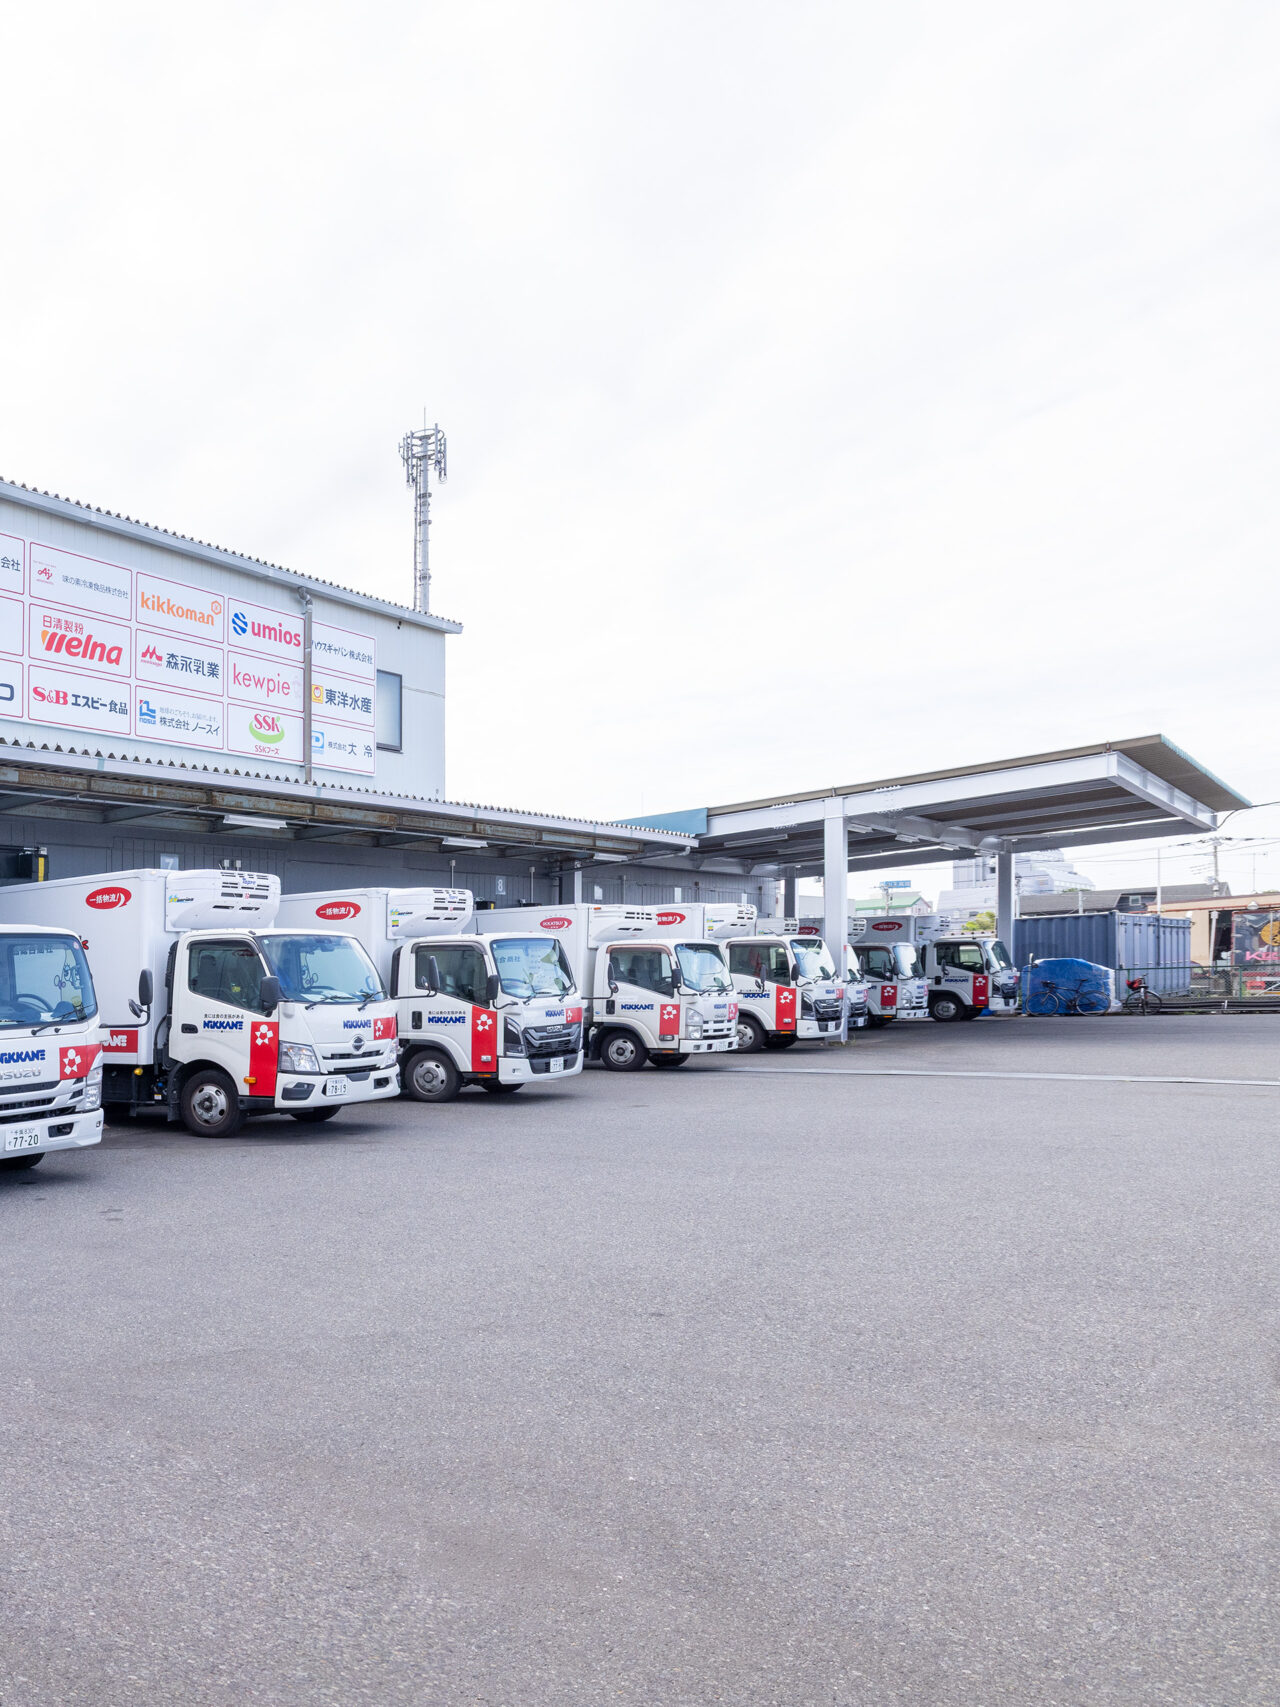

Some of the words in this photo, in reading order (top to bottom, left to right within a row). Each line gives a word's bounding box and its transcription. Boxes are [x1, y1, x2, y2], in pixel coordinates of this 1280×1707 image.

[141, 591, 215, 626] kikkoman
[42, 614, 84, 635] 日清製粉
[251, 621, 301, 647] umios
[41, 629, 123, 665] Welna
[166, 652, 220, 679] 森永乳業
[233, 663, 291, 698] kewpie
[32, 686, 68, 706] S&B
[71, 693, 129, 716] エスビー食品
[325, 688, 372, 714] 東洋水産
[159, 716, 190, 731] 株式会社
[191, 722, 220, 736] ノースイ
[254, 713, 280, 733] SSK
[497, 879, 503, 892] 8
[621, 1003, 654, 1011] NIKKANE
[203, 1020, 244, 1030] NIKKANE
[343, 1019, 372, 1029] NIKKANE
[428, 1016, 466, 1024] NIKKANE
[0, 1067, 42, 1081] ISUZU
[13, 1134, 39, 1148] 77-20
